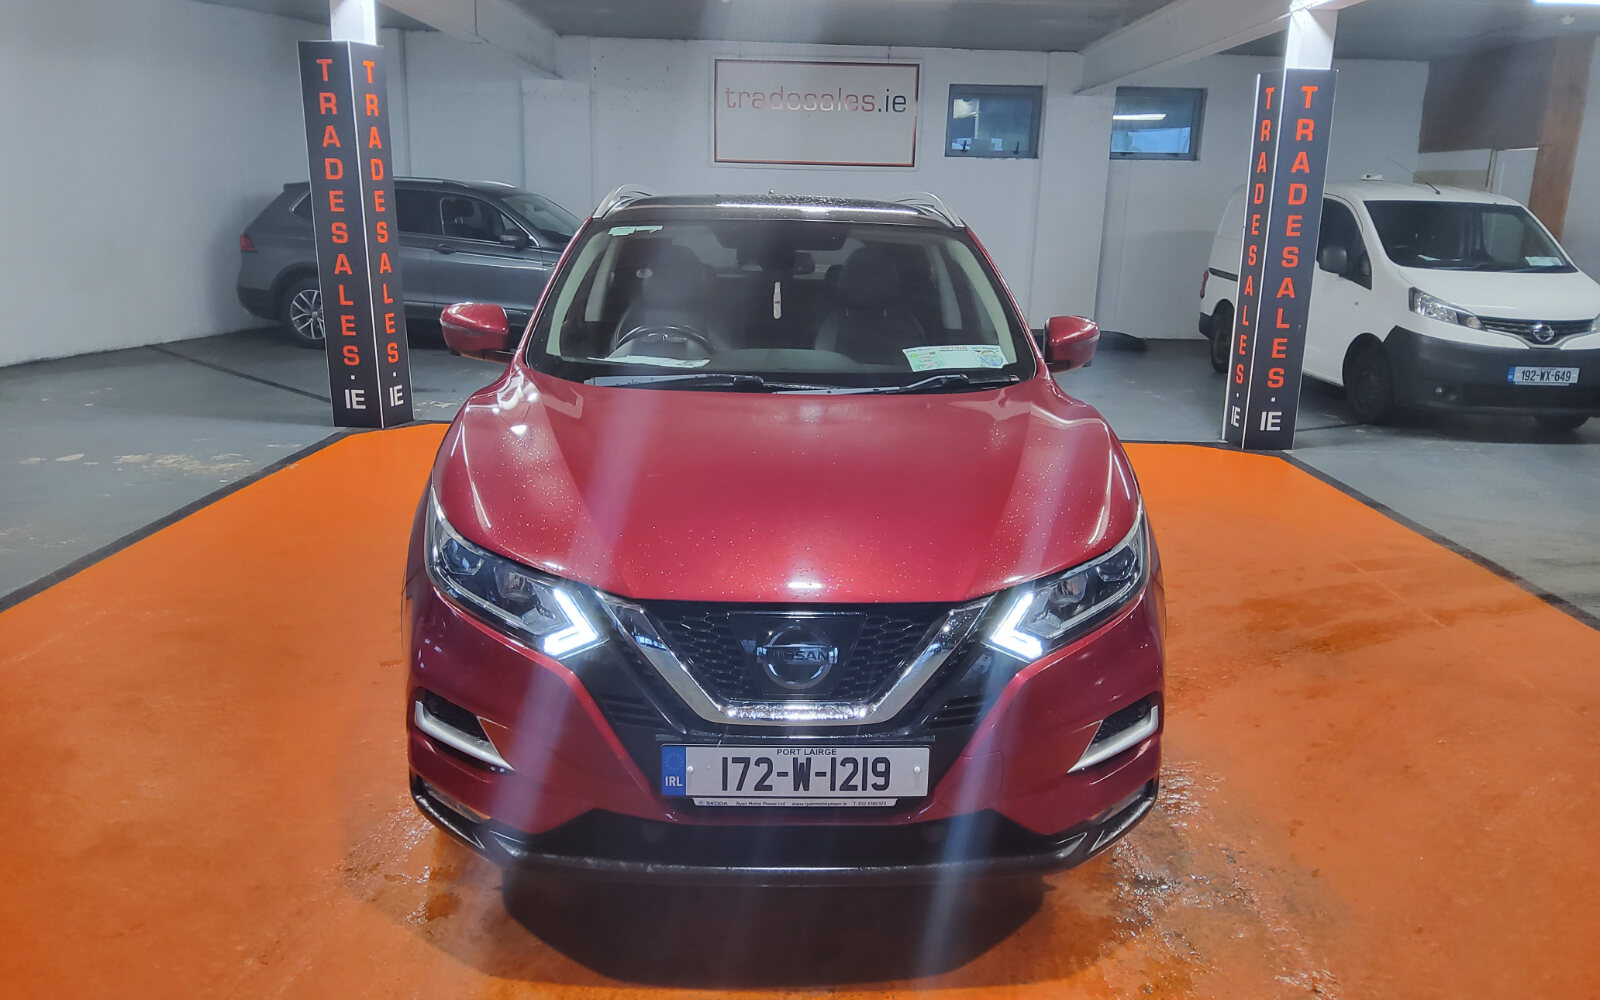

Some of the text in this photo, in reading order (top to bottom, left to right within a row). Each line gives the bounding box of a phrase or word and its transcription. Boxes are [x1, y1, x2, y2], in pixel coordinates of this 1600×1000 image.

[725, 86, 907, 113] tradesales.ie
[1521, 369, 1572, 382] 192-WX-649
[776, 748, 837, 756] PORT LAIRGE
[721, 756, 891, 792] 172-W-1219
[665, 775, 683, 787] IRL
